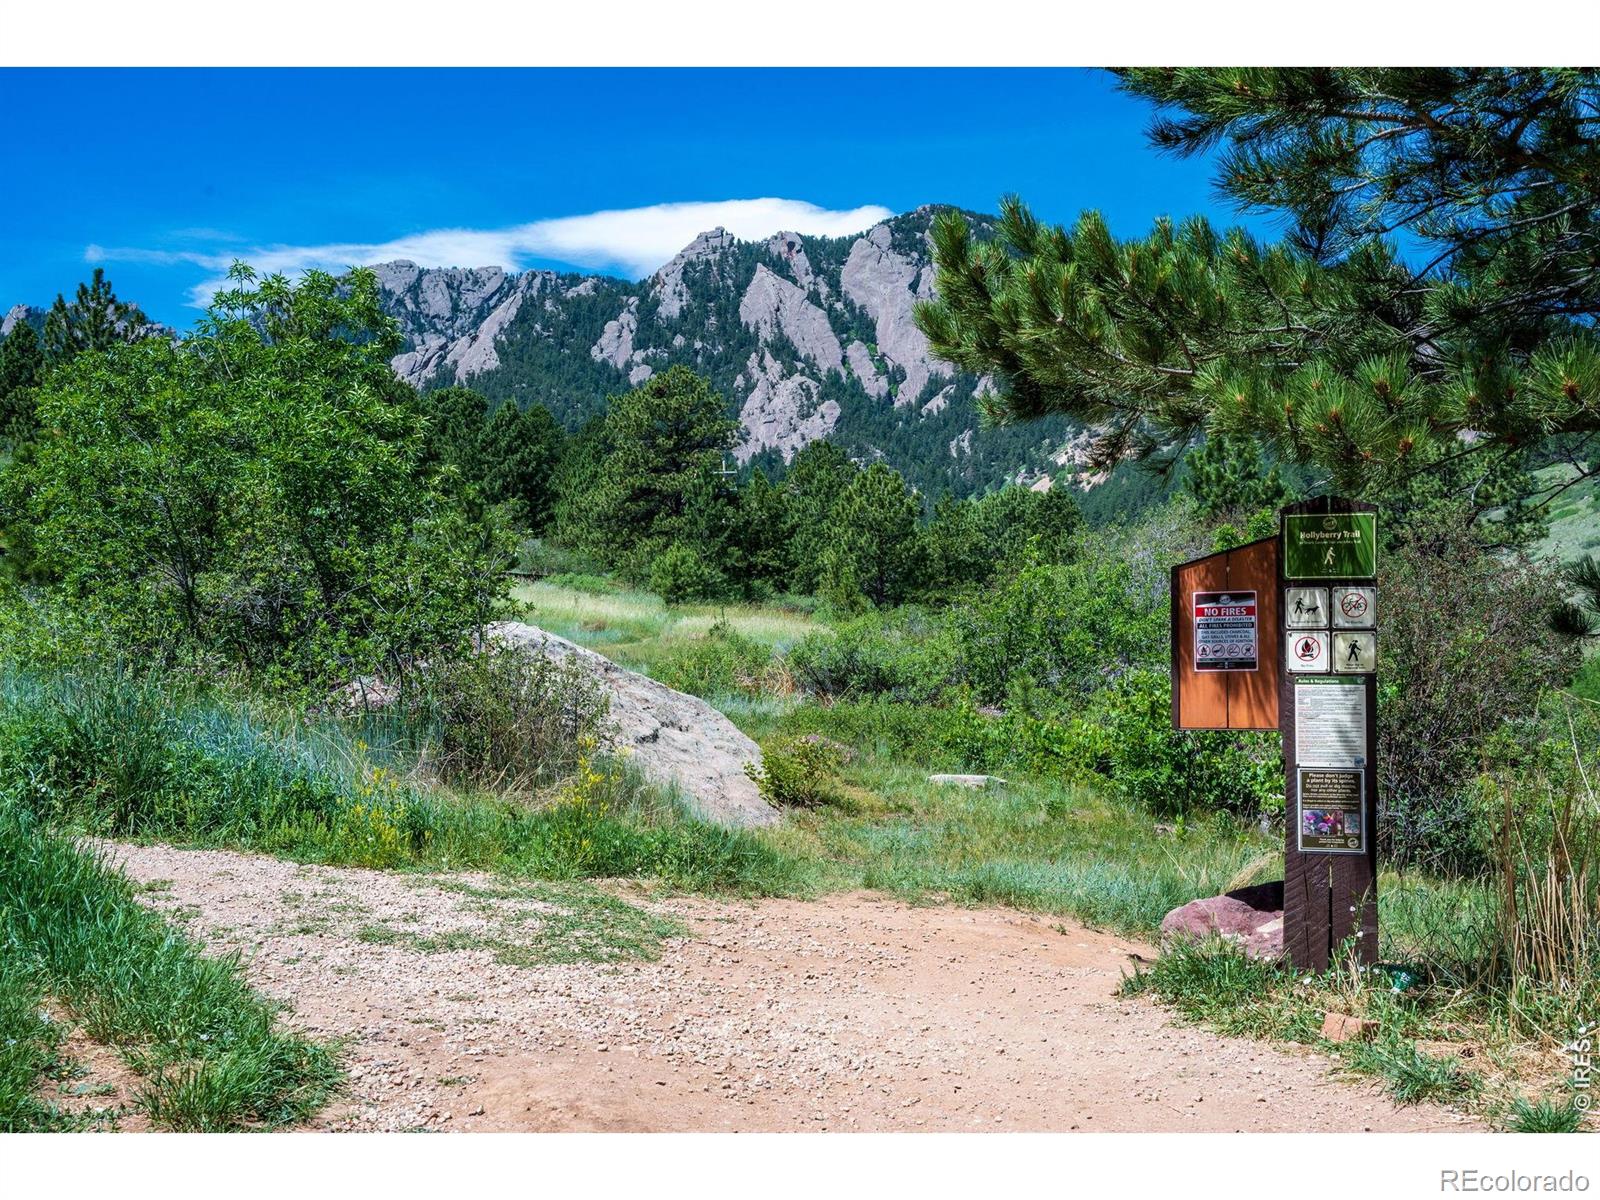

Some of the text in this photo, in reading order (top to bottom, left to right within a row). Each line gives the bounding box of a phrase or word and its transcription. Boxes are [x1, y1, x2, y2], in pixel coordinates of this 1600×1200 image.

[1300, 530, 1361, 540] Hollyberry Trail
[1204, 607, 1247, 616] NO FIRES
